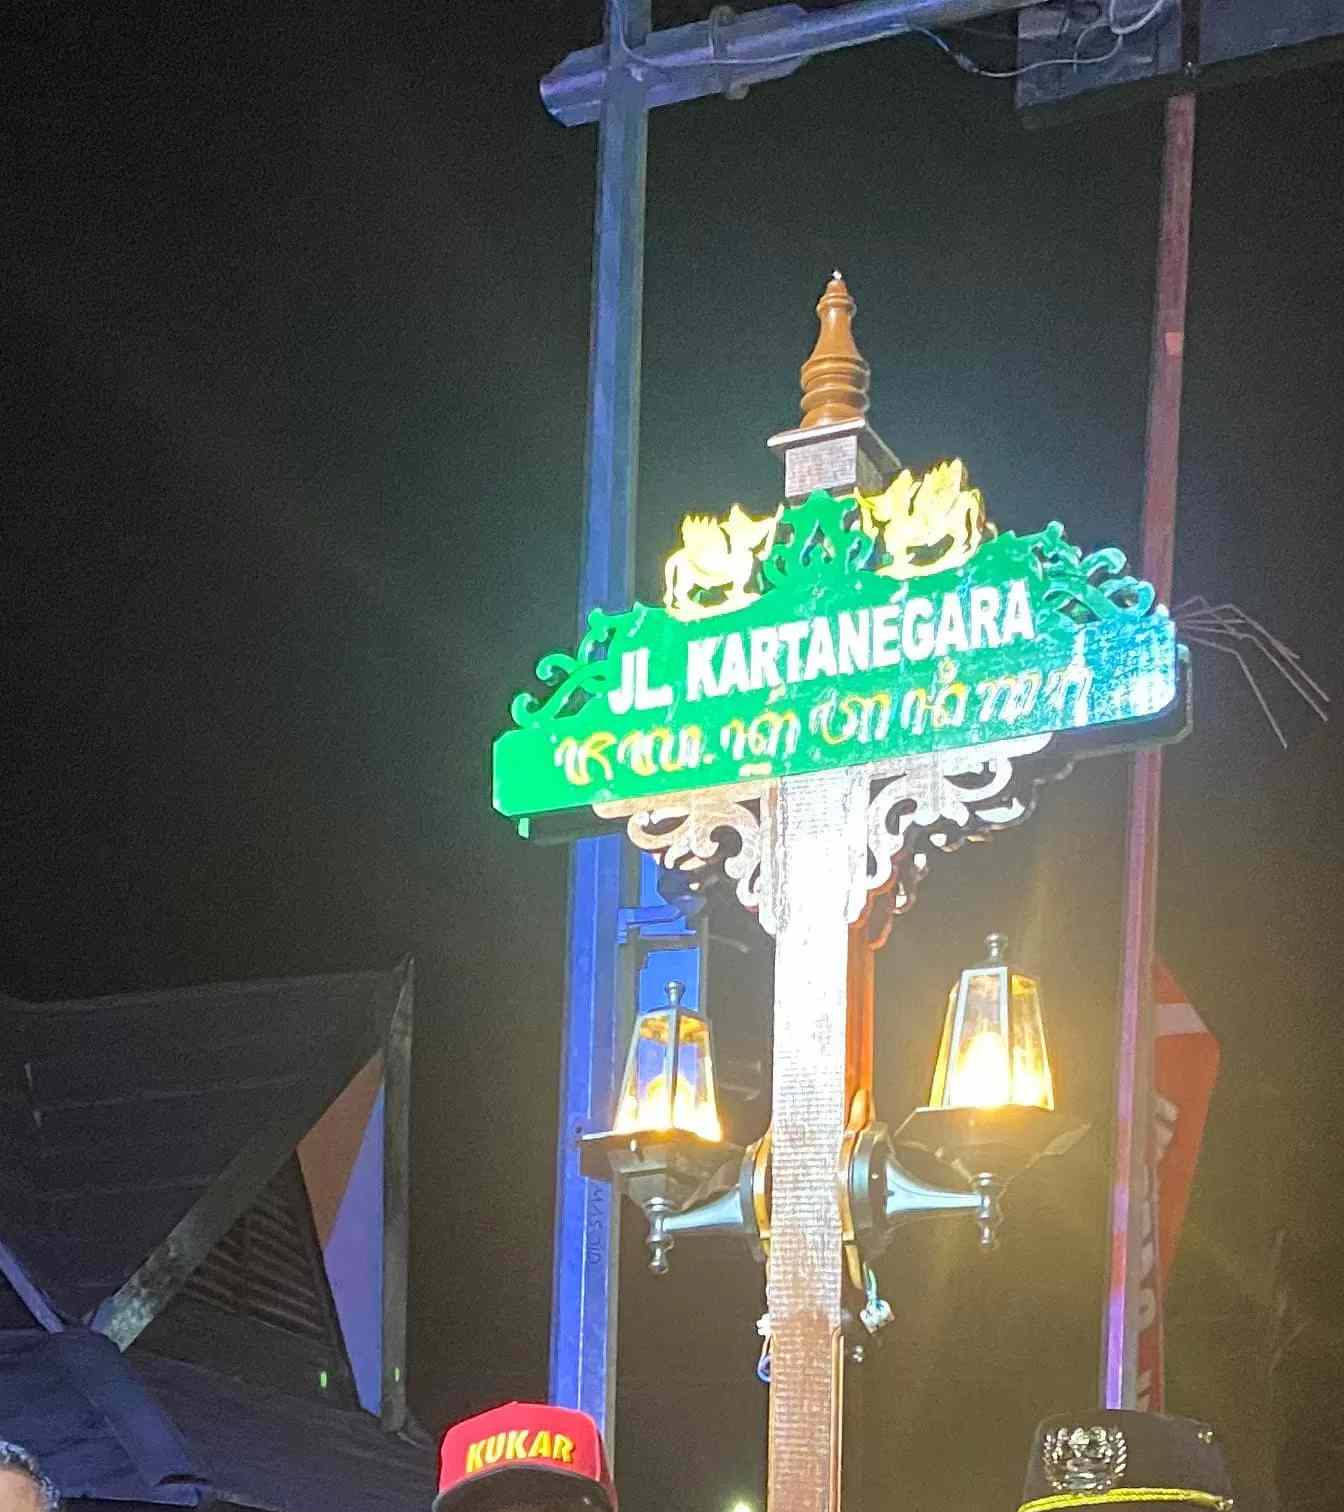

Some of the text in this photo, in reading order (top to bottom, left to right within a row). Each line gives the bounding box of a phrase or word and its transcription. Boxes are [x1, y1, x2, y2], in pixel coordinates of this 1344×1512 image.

[608, 580, 1035, 715] JL KARTANEGARA
[465, 1430, 574, 1474] KUKAR
